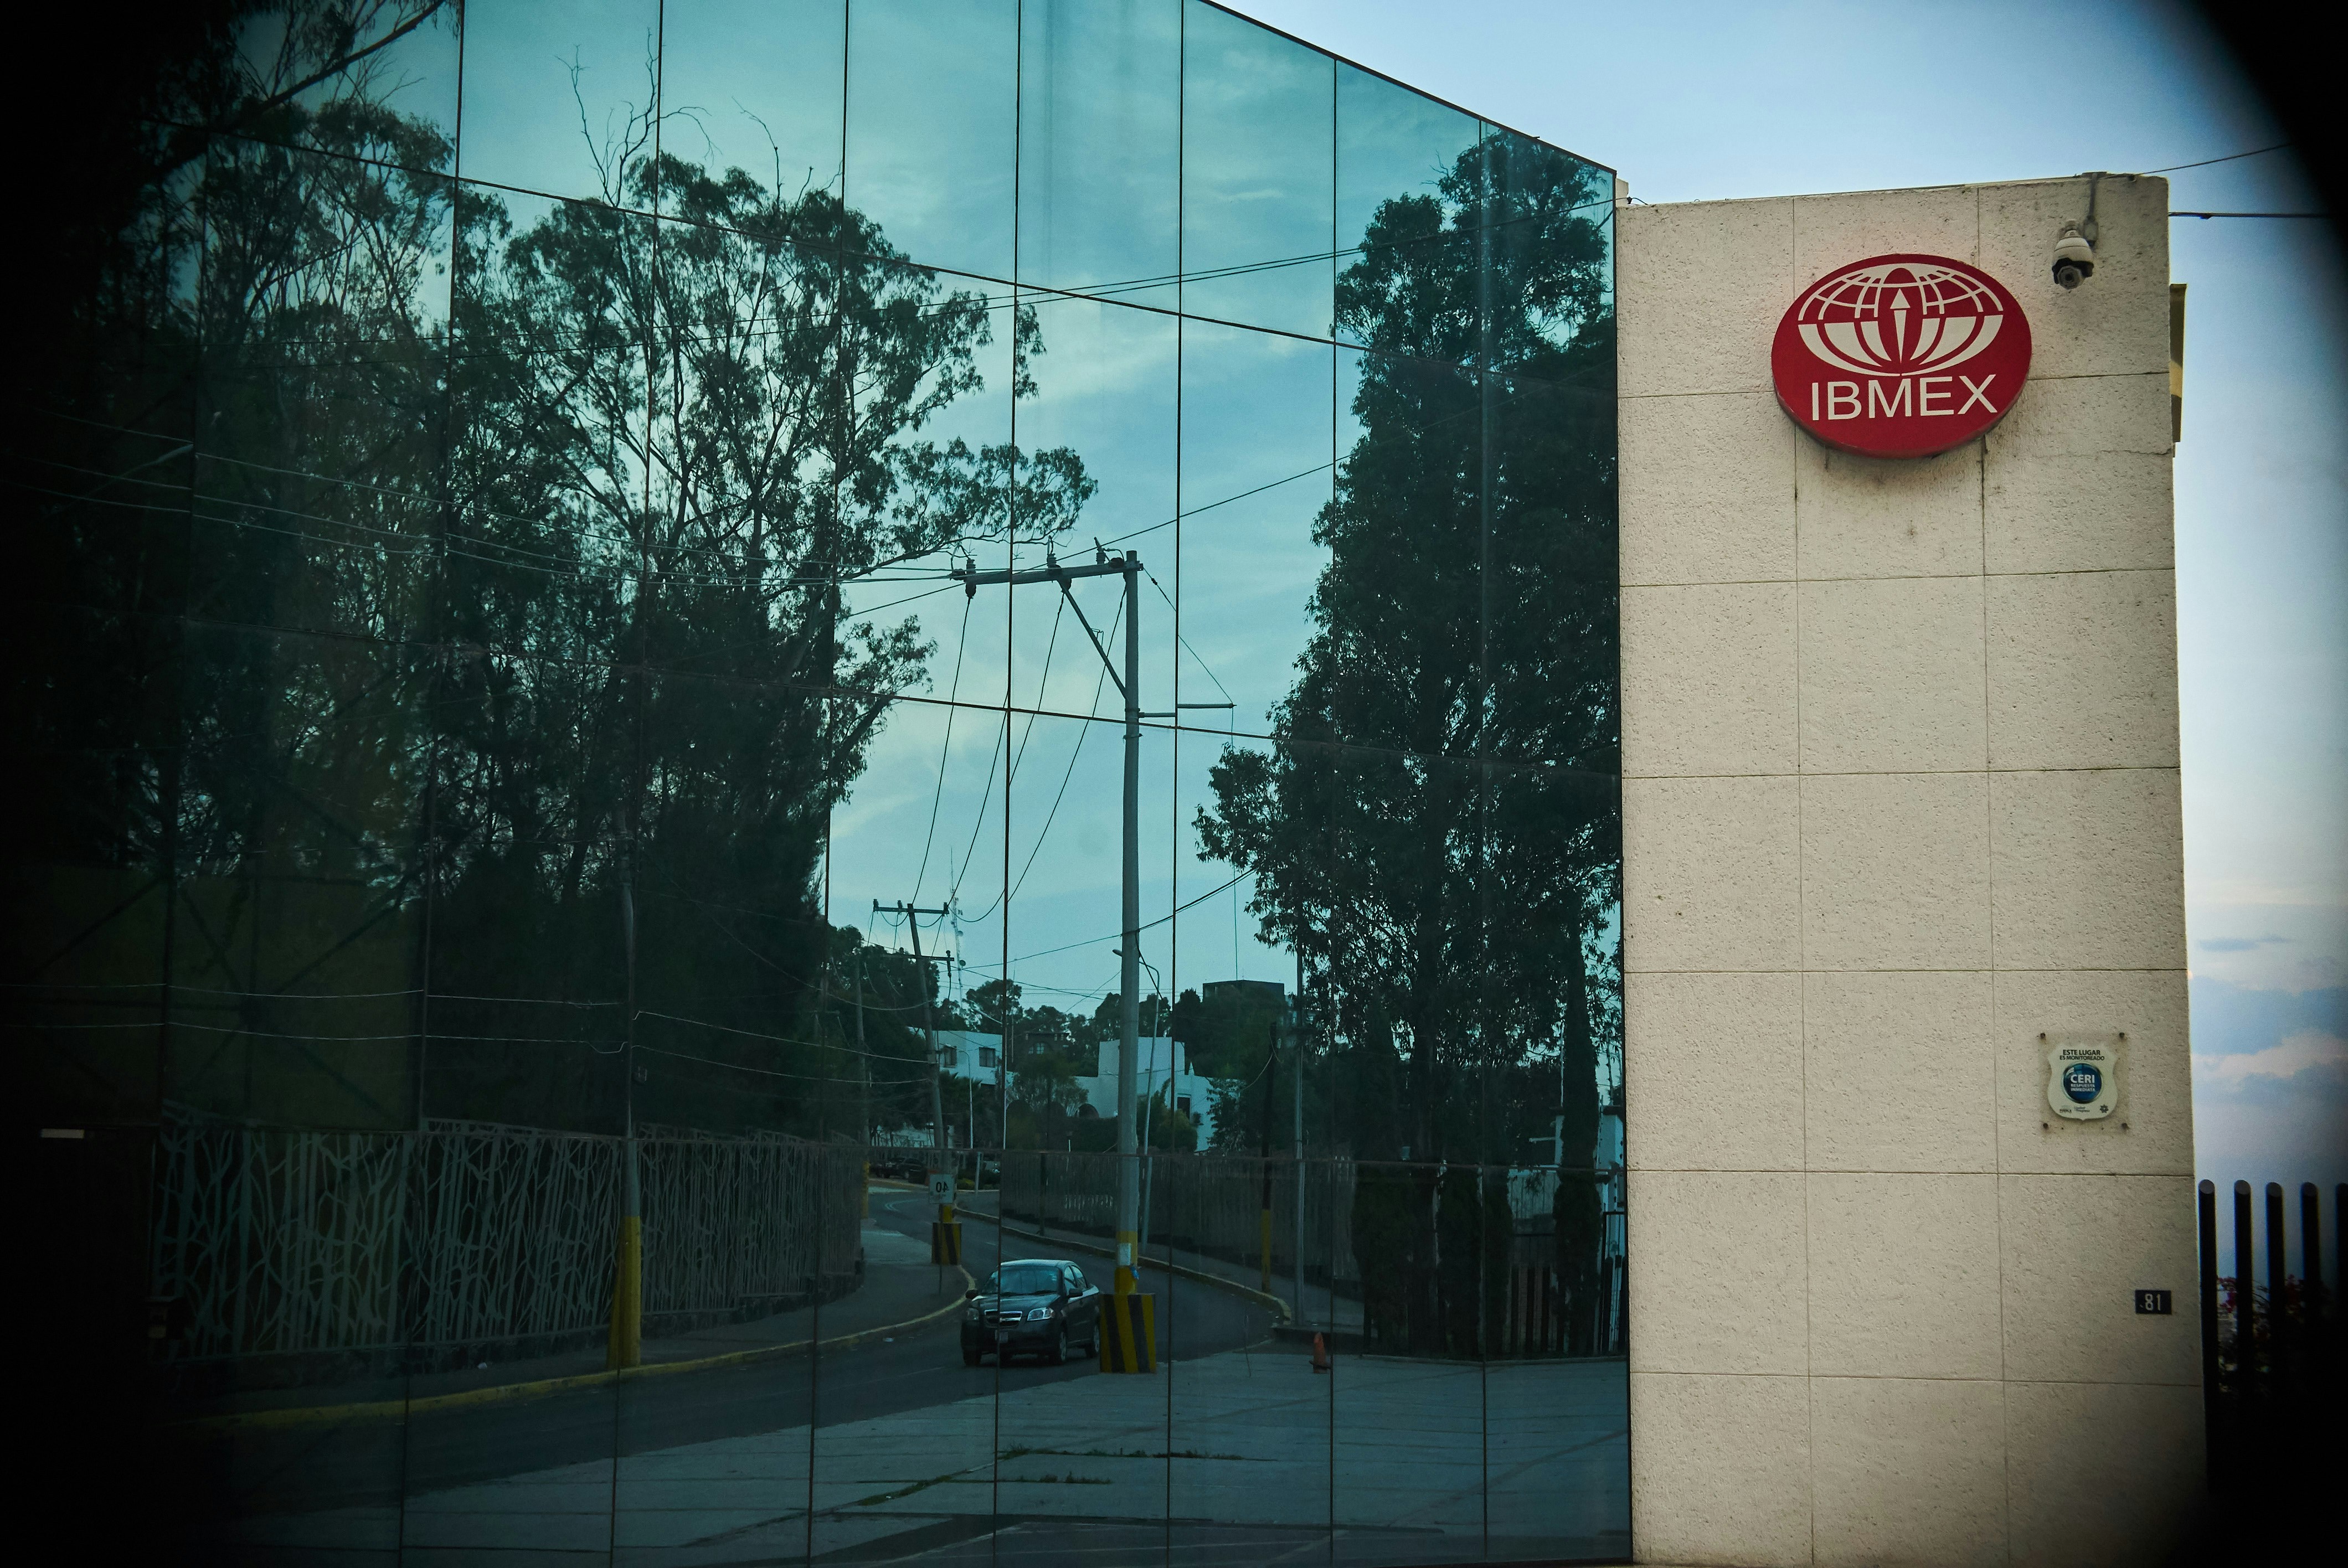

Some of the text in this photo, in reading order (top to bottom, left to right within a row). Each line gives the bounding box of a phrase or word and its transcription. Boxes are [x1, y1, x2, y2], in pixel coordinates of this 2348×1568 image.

[1811, 374, 1998, 421] IBMEX
[2071, 1075, 2095, 1084] CERI
[2145, 1293, 2161, 1311] 81
